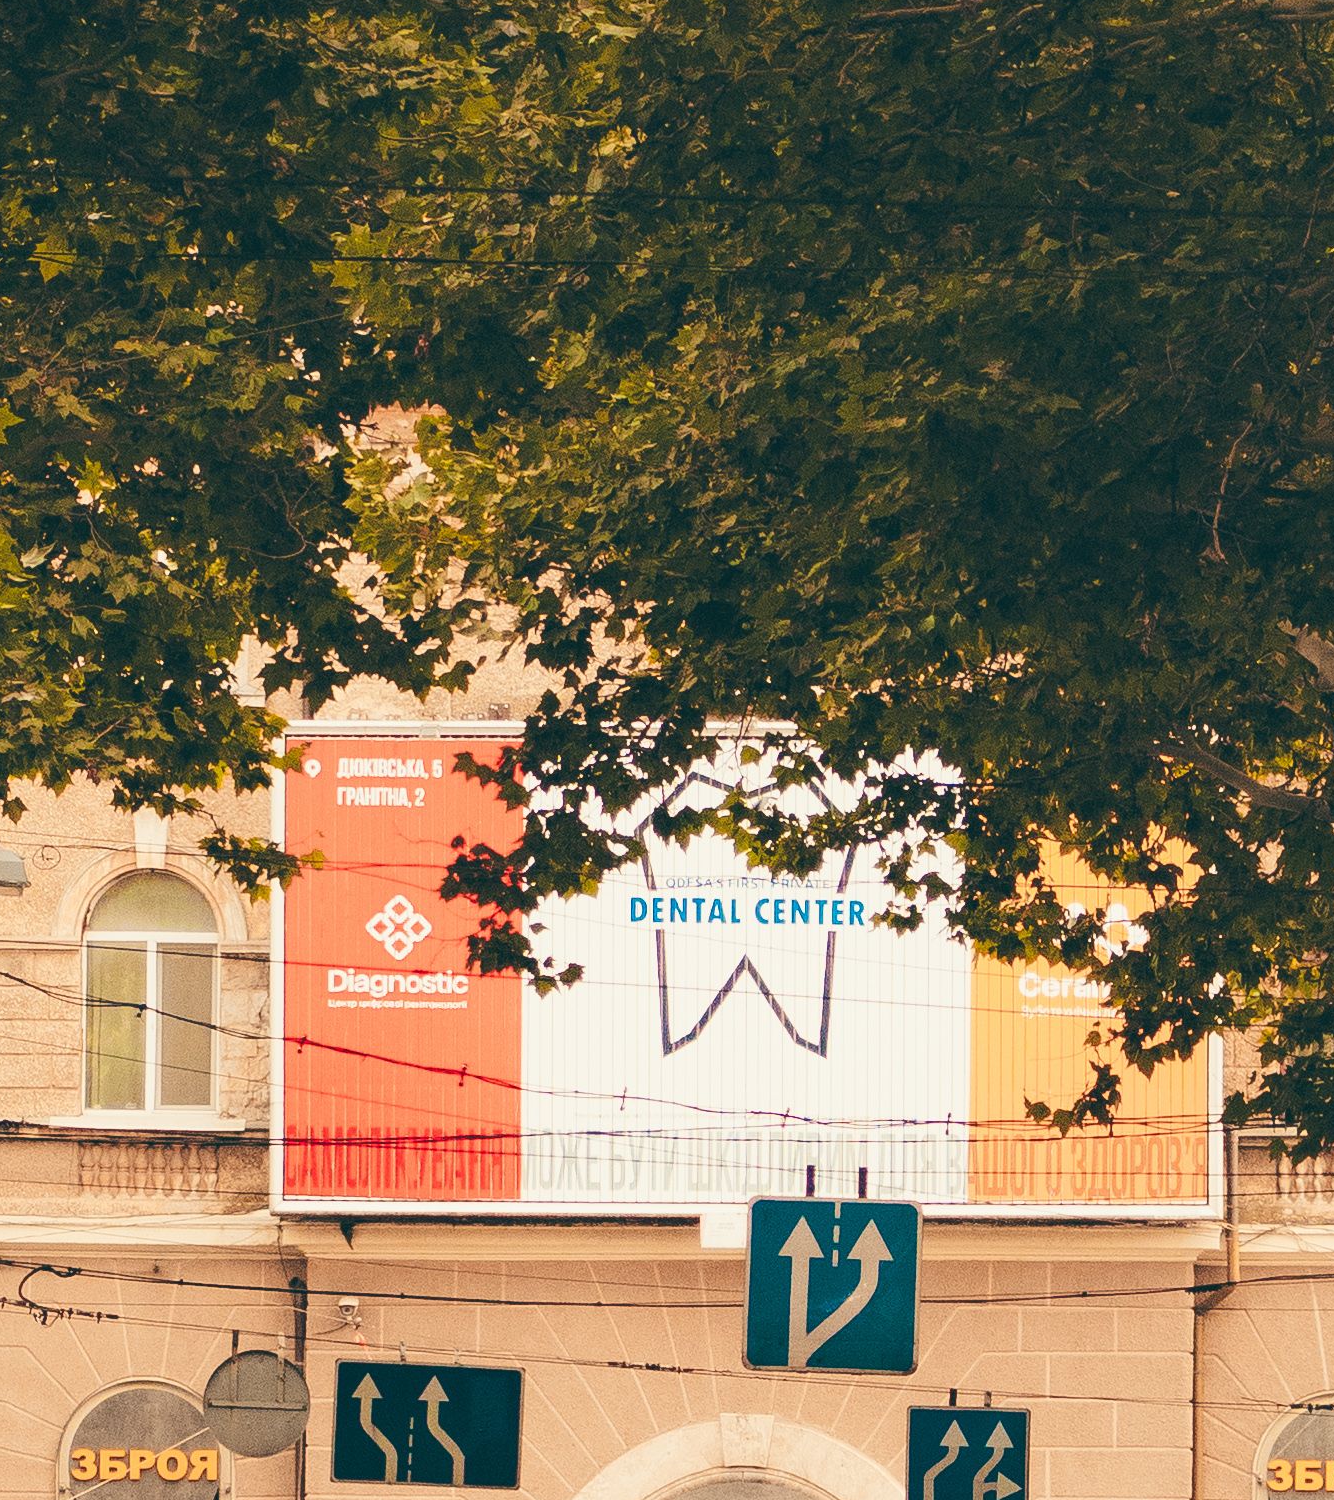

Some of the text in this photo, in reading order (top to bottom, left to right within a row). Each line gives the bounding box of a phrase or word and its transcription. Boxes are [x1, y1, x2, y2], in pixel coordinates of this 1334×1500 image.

[431, 759, 443, 779] 5
[414, 788, 426, 807] 2
[630, 897, 865, 925] DENTAL CENTER
[327, 969, 469, 998] Diagnostic
[71, 1447, 218, 1481] ЗБРОЯ
